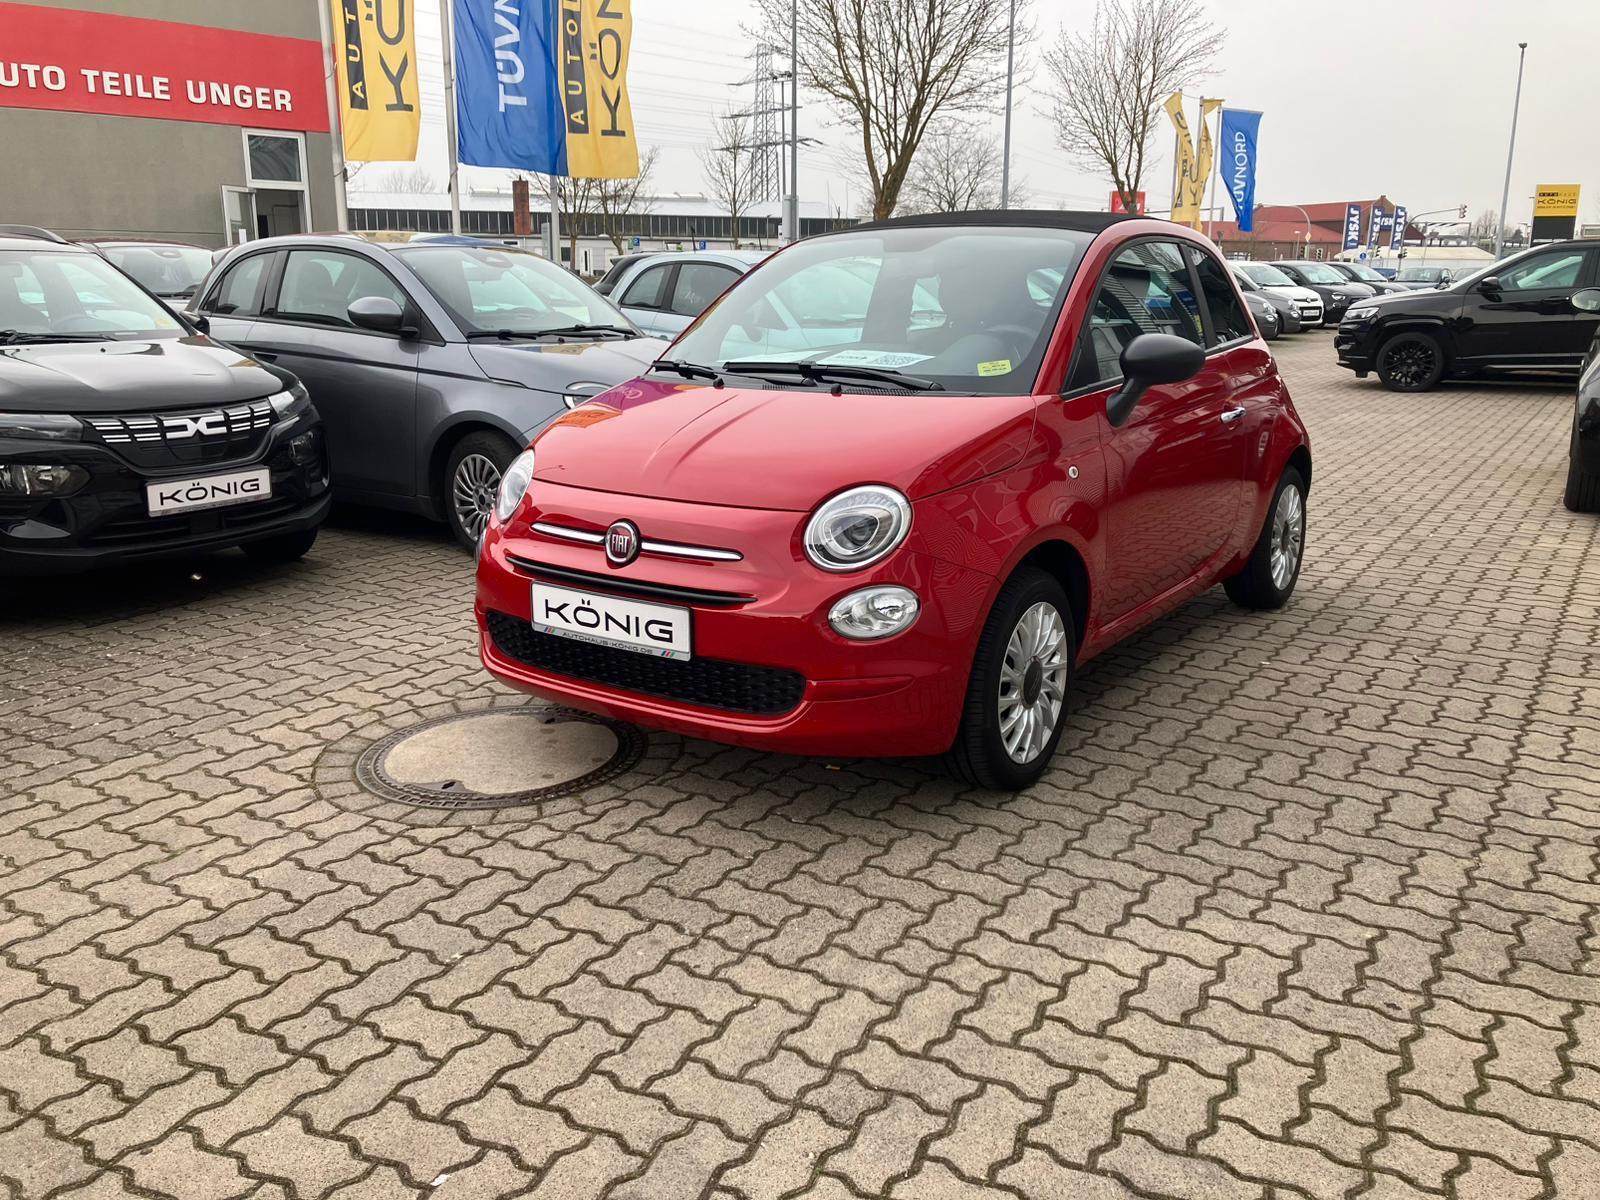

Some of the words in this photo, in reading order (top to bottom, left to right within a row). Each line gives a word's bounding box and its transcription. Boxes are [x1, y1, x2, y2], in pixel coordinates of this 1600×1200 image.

[565, 0, 586, 126] AUTO
[80, 68, 171, 100] TEILE
[186, 79, 292, 112] UNGER
[1348, 208, 1359, 241] JYSK
[160, 478, 260, 506] KÖNIG
[611, 533, 630, 554] FIAT
[545, 598, 674, 643] KÖNIG
